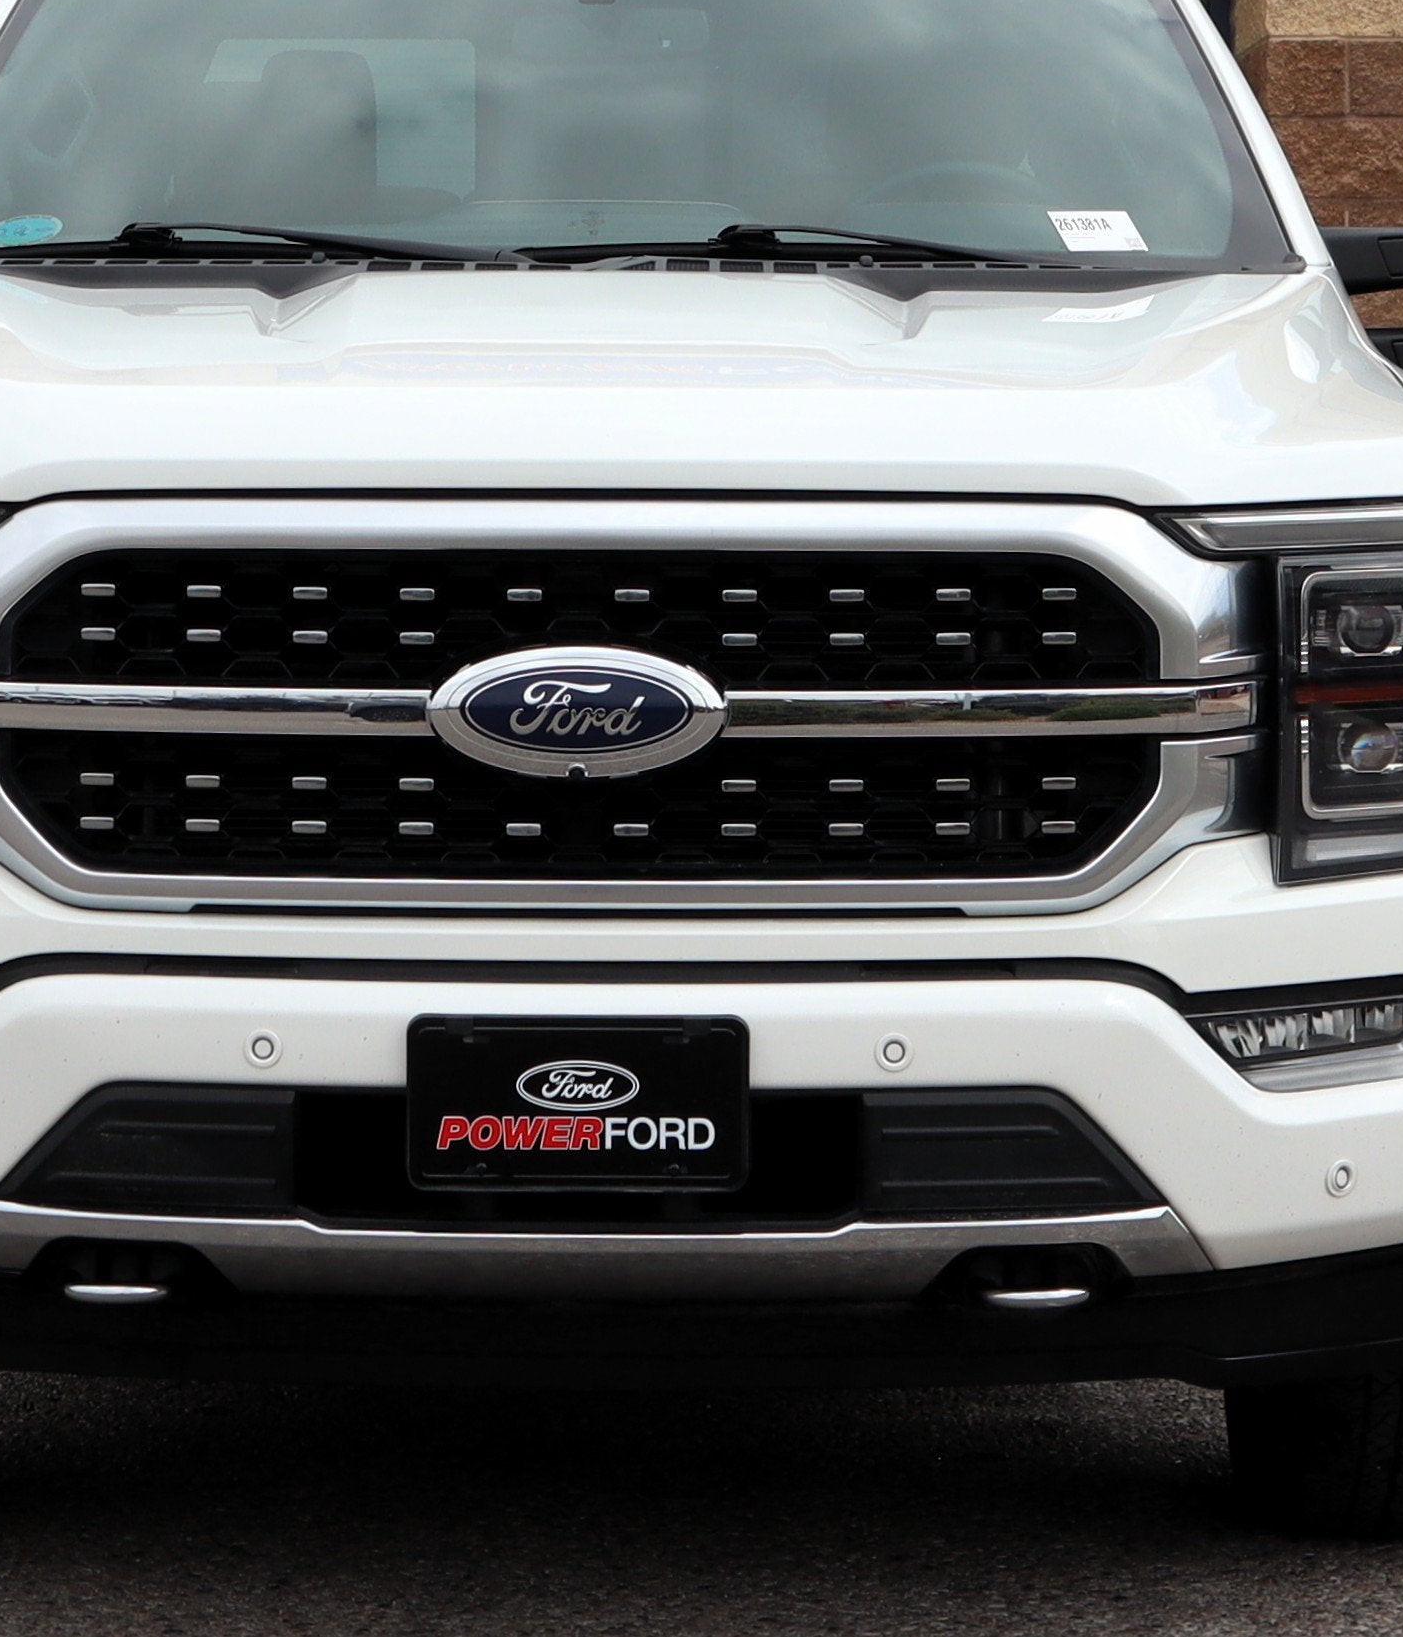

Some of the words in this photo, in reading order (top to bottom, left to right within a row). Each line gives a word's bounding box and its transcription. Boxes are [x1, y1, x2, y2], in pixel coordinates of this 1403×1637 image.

[1055, 218, 1112, 231] 261381A
[509, 679, 645, 736] Ford
[542, 1069, 614, 1099] Ford
[436, 1115, 716, 1150] POWERFORD
